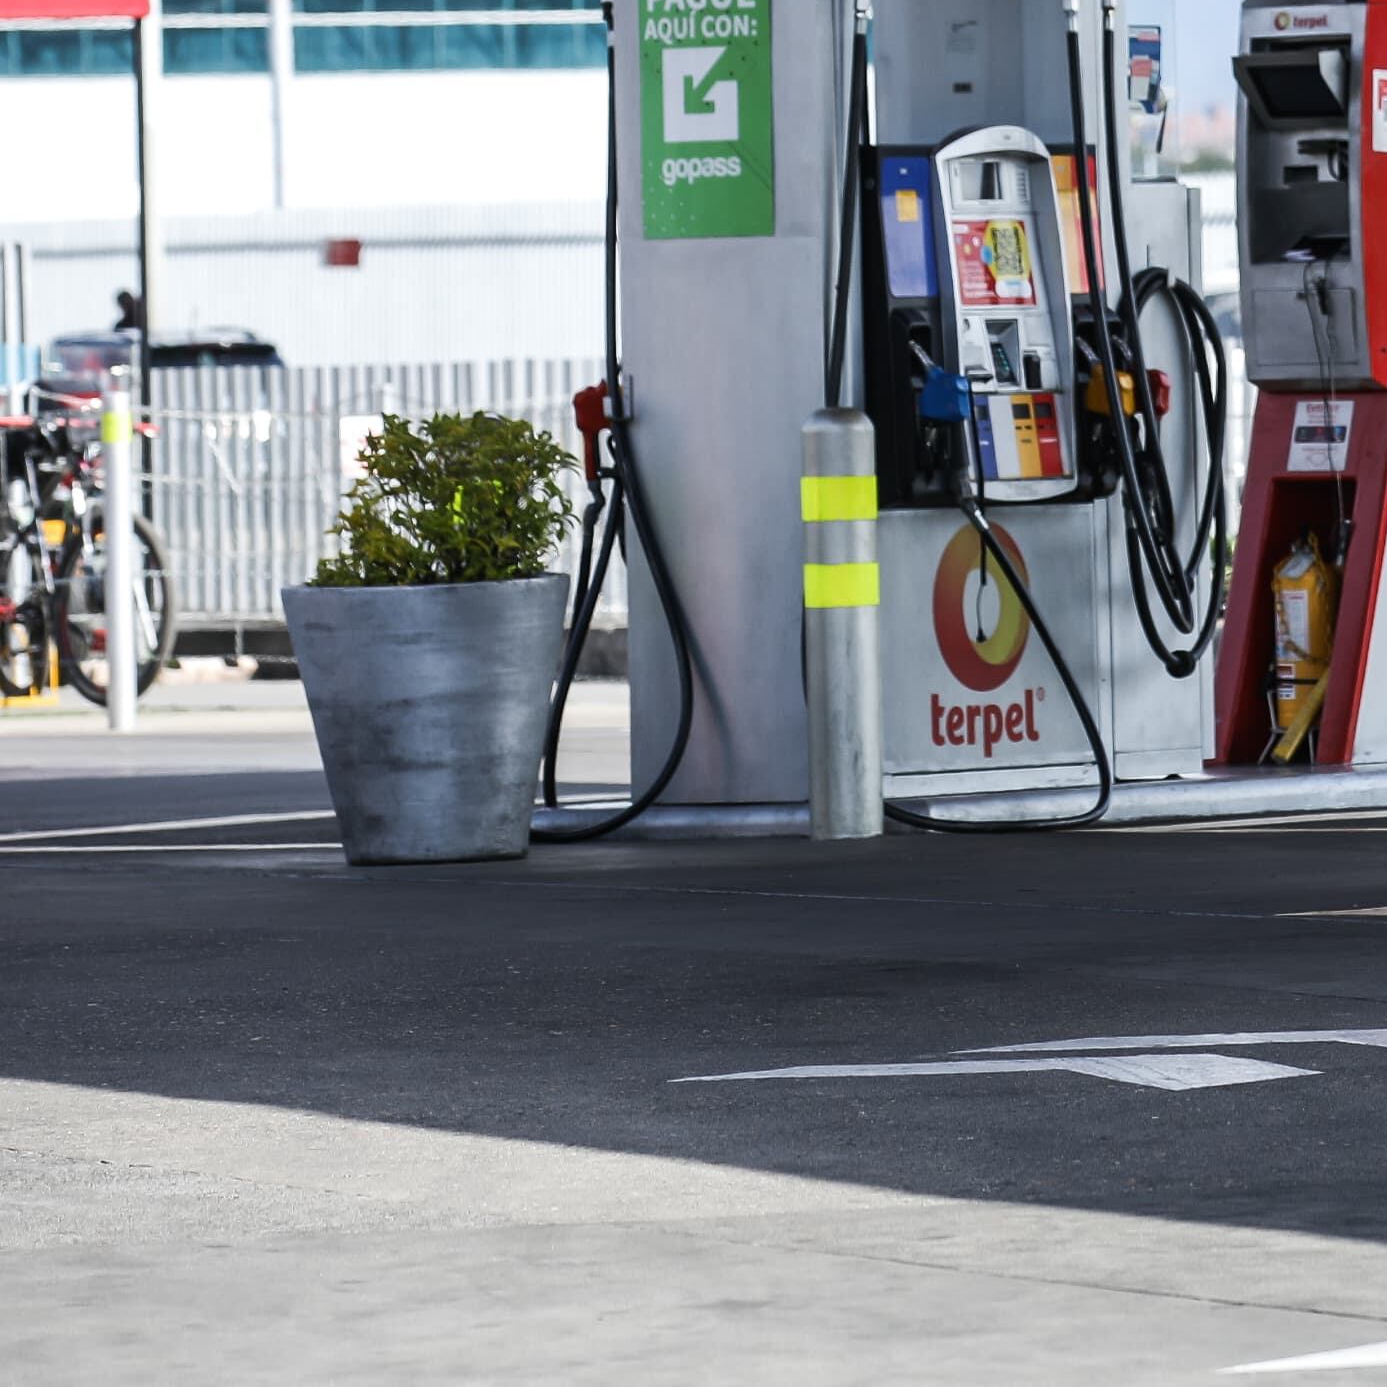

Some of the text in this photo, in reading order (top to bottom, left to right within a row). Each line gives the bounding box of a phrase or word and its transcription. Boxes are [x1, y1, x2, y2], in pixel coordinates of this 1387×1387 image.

[645, 8, 758, 43] AQUÍ CON:
[662, 156, 741, 184] gopass
[931, 689, 1040, 758] terpel
